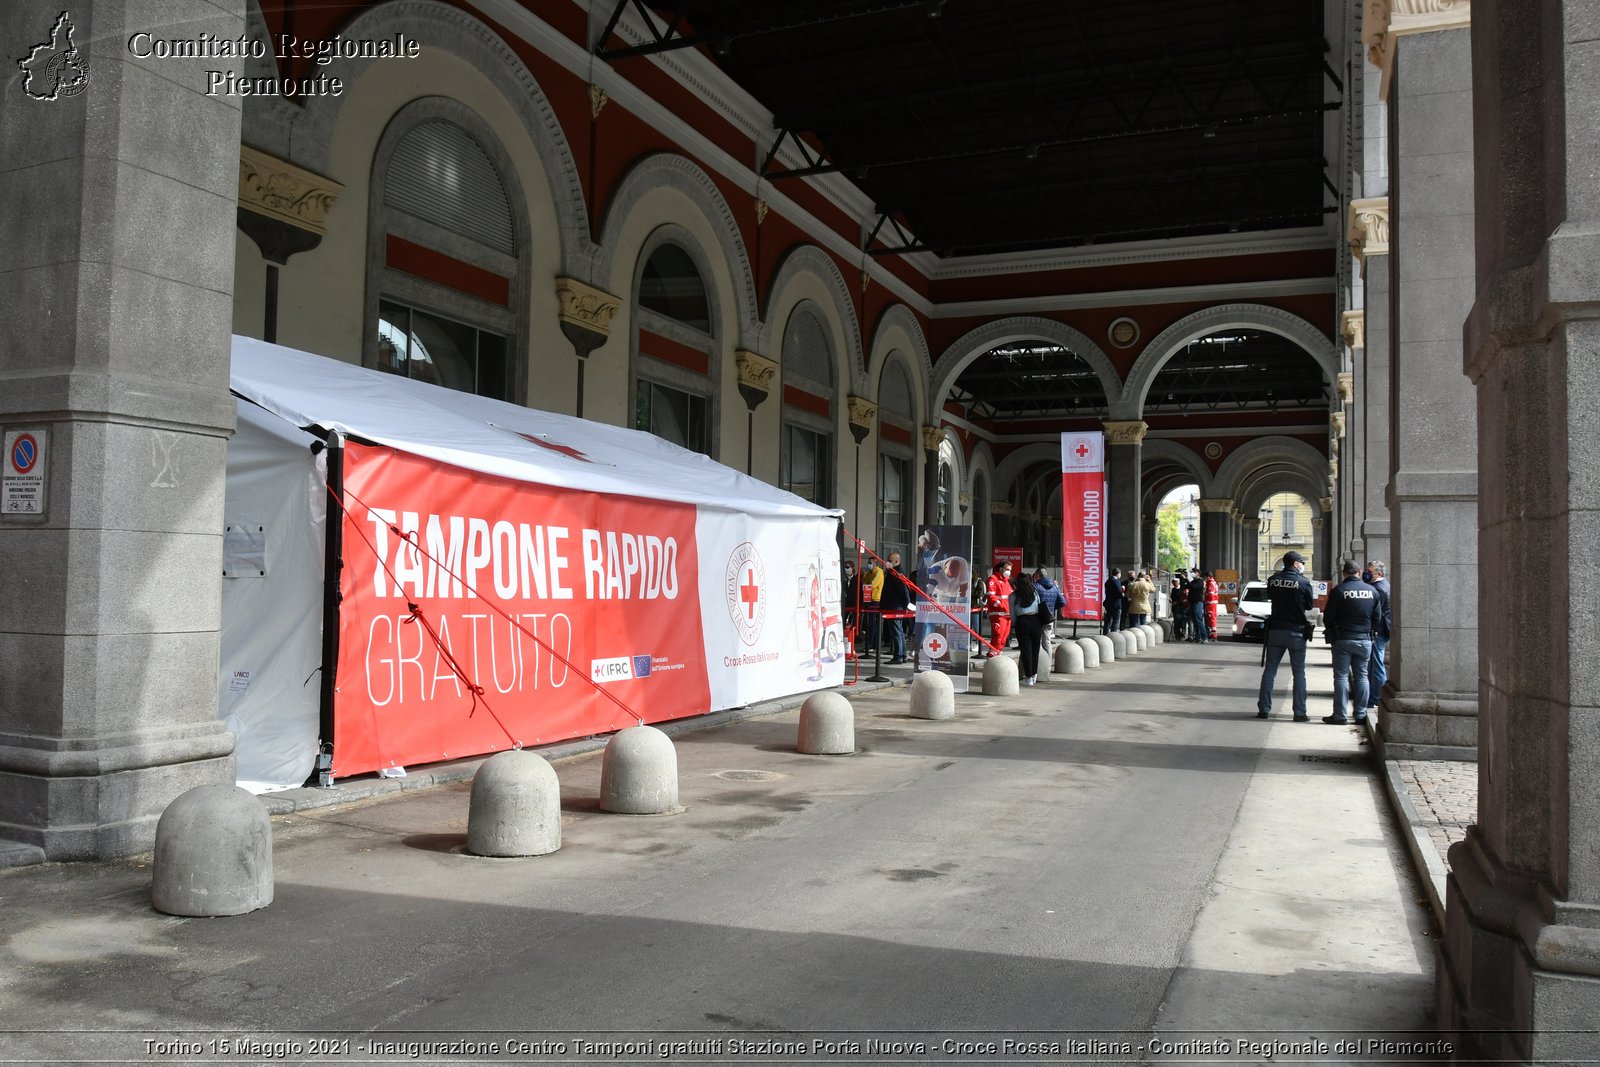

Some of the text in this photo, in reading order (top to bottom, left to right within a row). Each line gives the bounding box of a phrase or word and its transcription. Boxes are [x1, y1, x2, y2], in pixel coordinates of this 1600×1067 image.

[367, 507, 573, 600] TAMPONE
[583, 528, 679, 600] RAPIDO
[1269, 578, 1299, 590] POLIZIA
[1343, 589, 1374, 600] POLIZIA
[365, 612, 572, 706] GRATUITO
[723, 656, 742, 668] Croce
